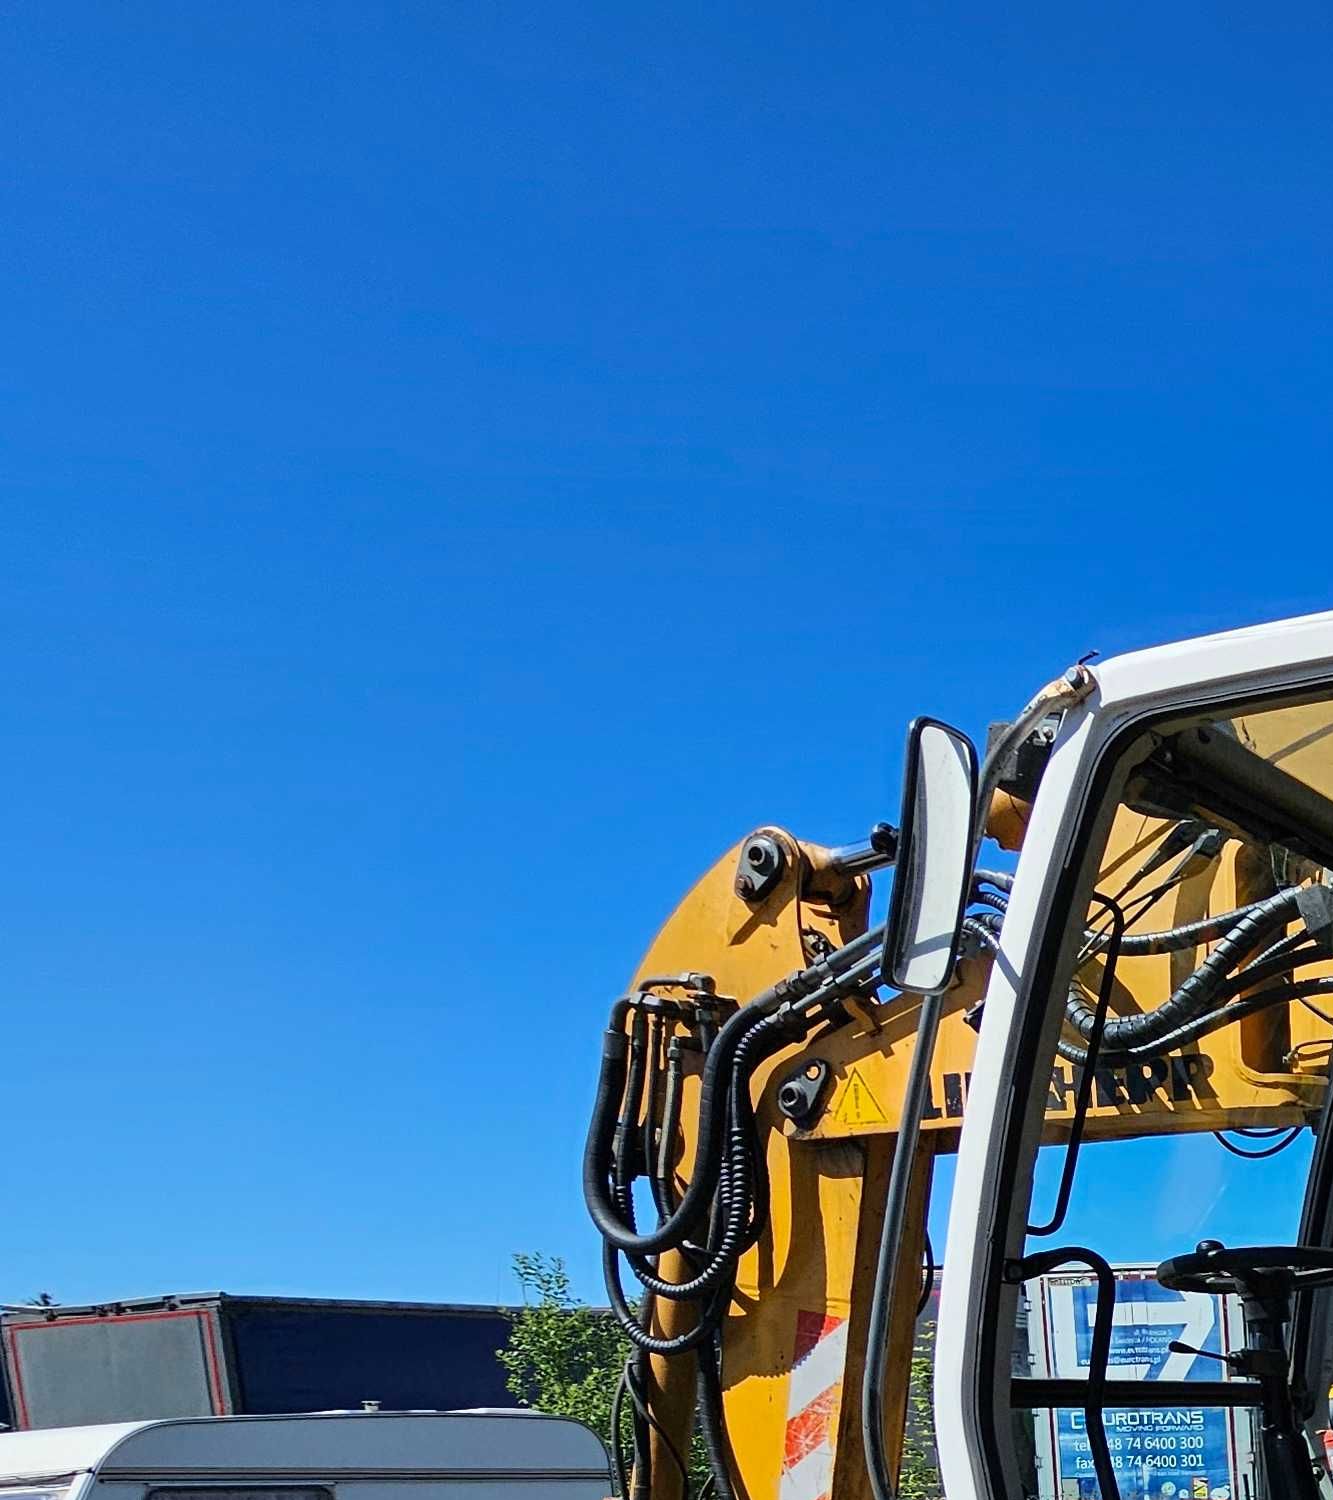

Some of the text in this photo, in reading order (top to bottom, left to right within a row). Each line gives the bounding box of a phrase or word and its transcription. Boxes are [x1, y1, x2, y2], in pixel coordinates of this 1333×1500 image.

[920, 1053, 1220, 1120] LIHERR
[1102, 1410, 1204, 1426] UROTRANS
[1125, 1437, 1141, 1450] 74
[1144, 1436, 1176, 1450] 6400
[1179, 1436, 1204, 1449] 300
[1126, 1455, 1142, 1468] 74
[1145, 1455, 1177, 1468] 6400
[1180, 1454, 1205, 1467] 301
